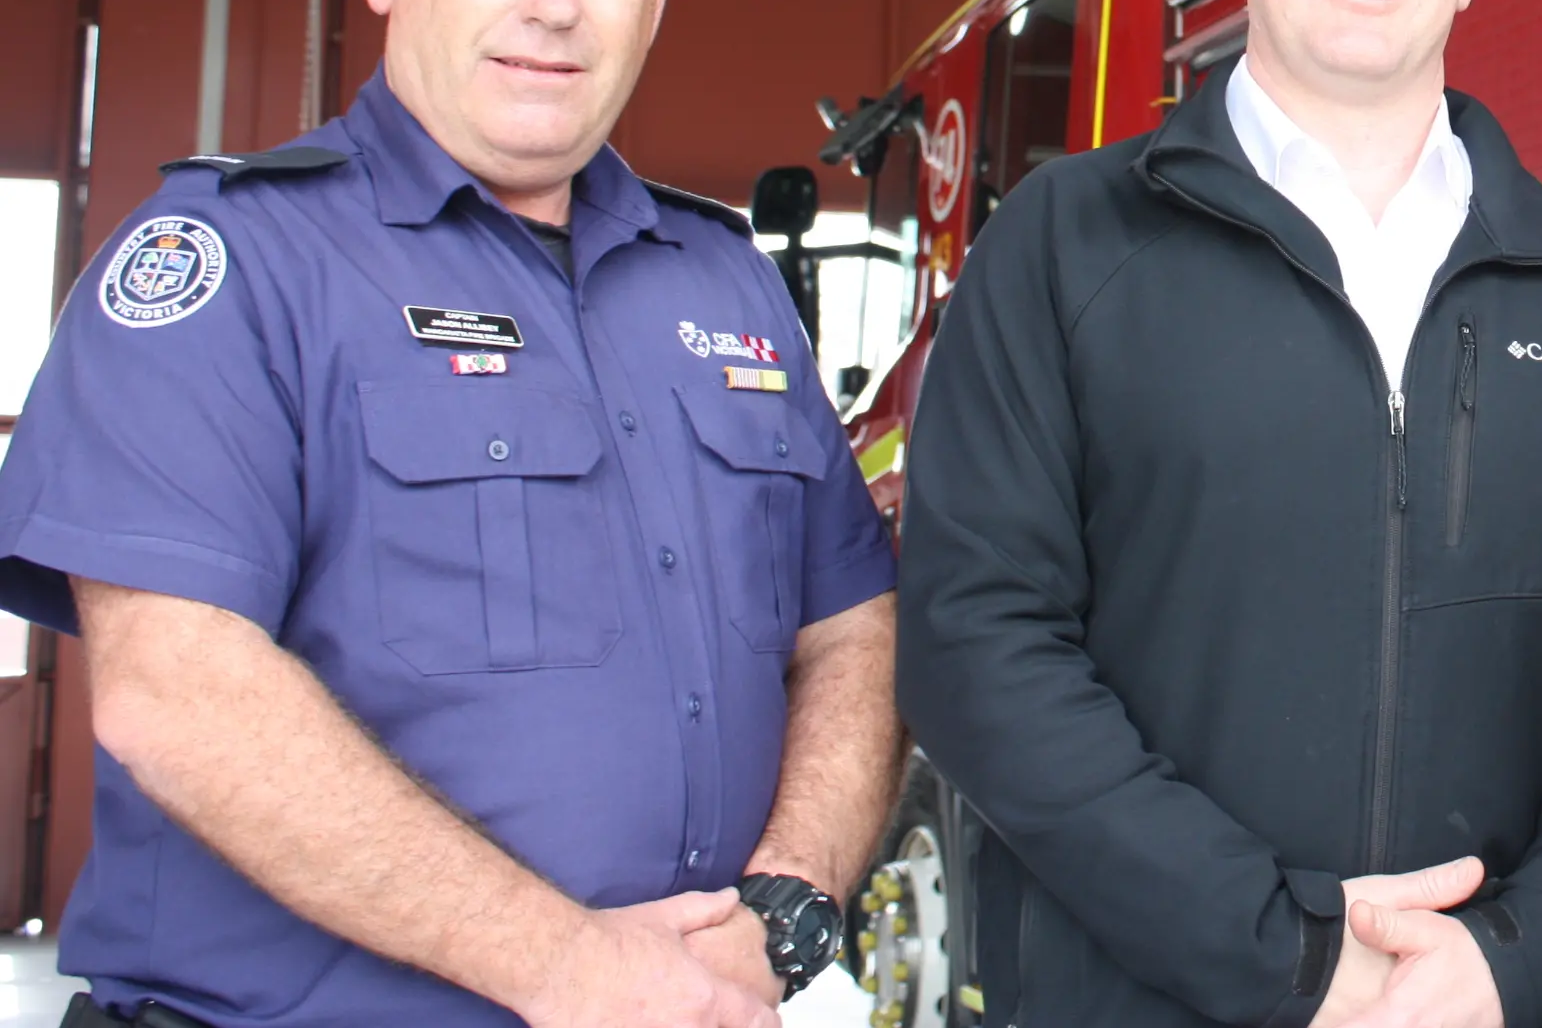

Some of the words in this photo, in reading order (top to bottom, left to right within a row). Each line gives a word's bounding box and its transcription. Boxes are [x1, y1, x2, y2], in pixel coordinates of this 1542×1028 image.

[152, 222, 185, 232] FIRE
[189, 228, 221, 289] AUTHORITY
[113, 300, 184, 320] VICTORIA
